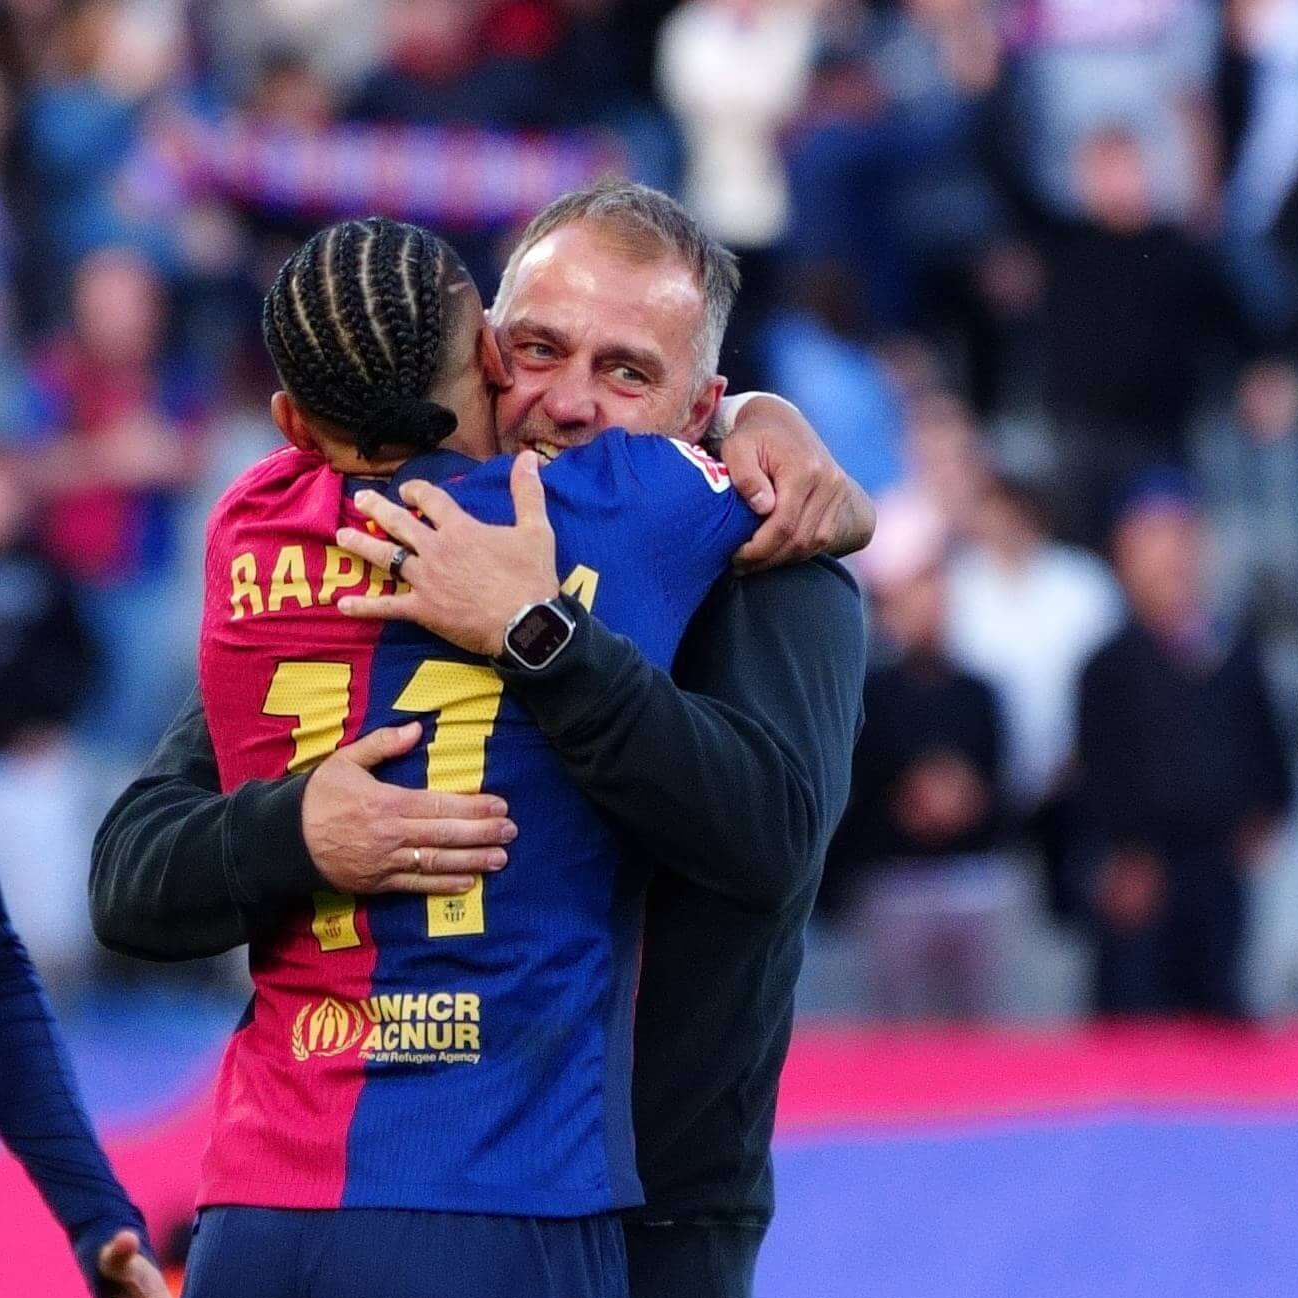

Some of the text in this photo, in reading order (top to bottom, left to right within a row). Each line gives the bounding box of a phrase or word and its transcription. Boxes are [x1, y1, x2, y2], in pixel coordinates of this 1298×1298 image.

[263, 660, 504, 952] 11
[359, 993, 481, 1022] UNHCR
[360, 1022, 481, 1051] ACNUR
[390, 1051, 436, 1064] Refugee
[438, 1051, 481, 1065] Agency
